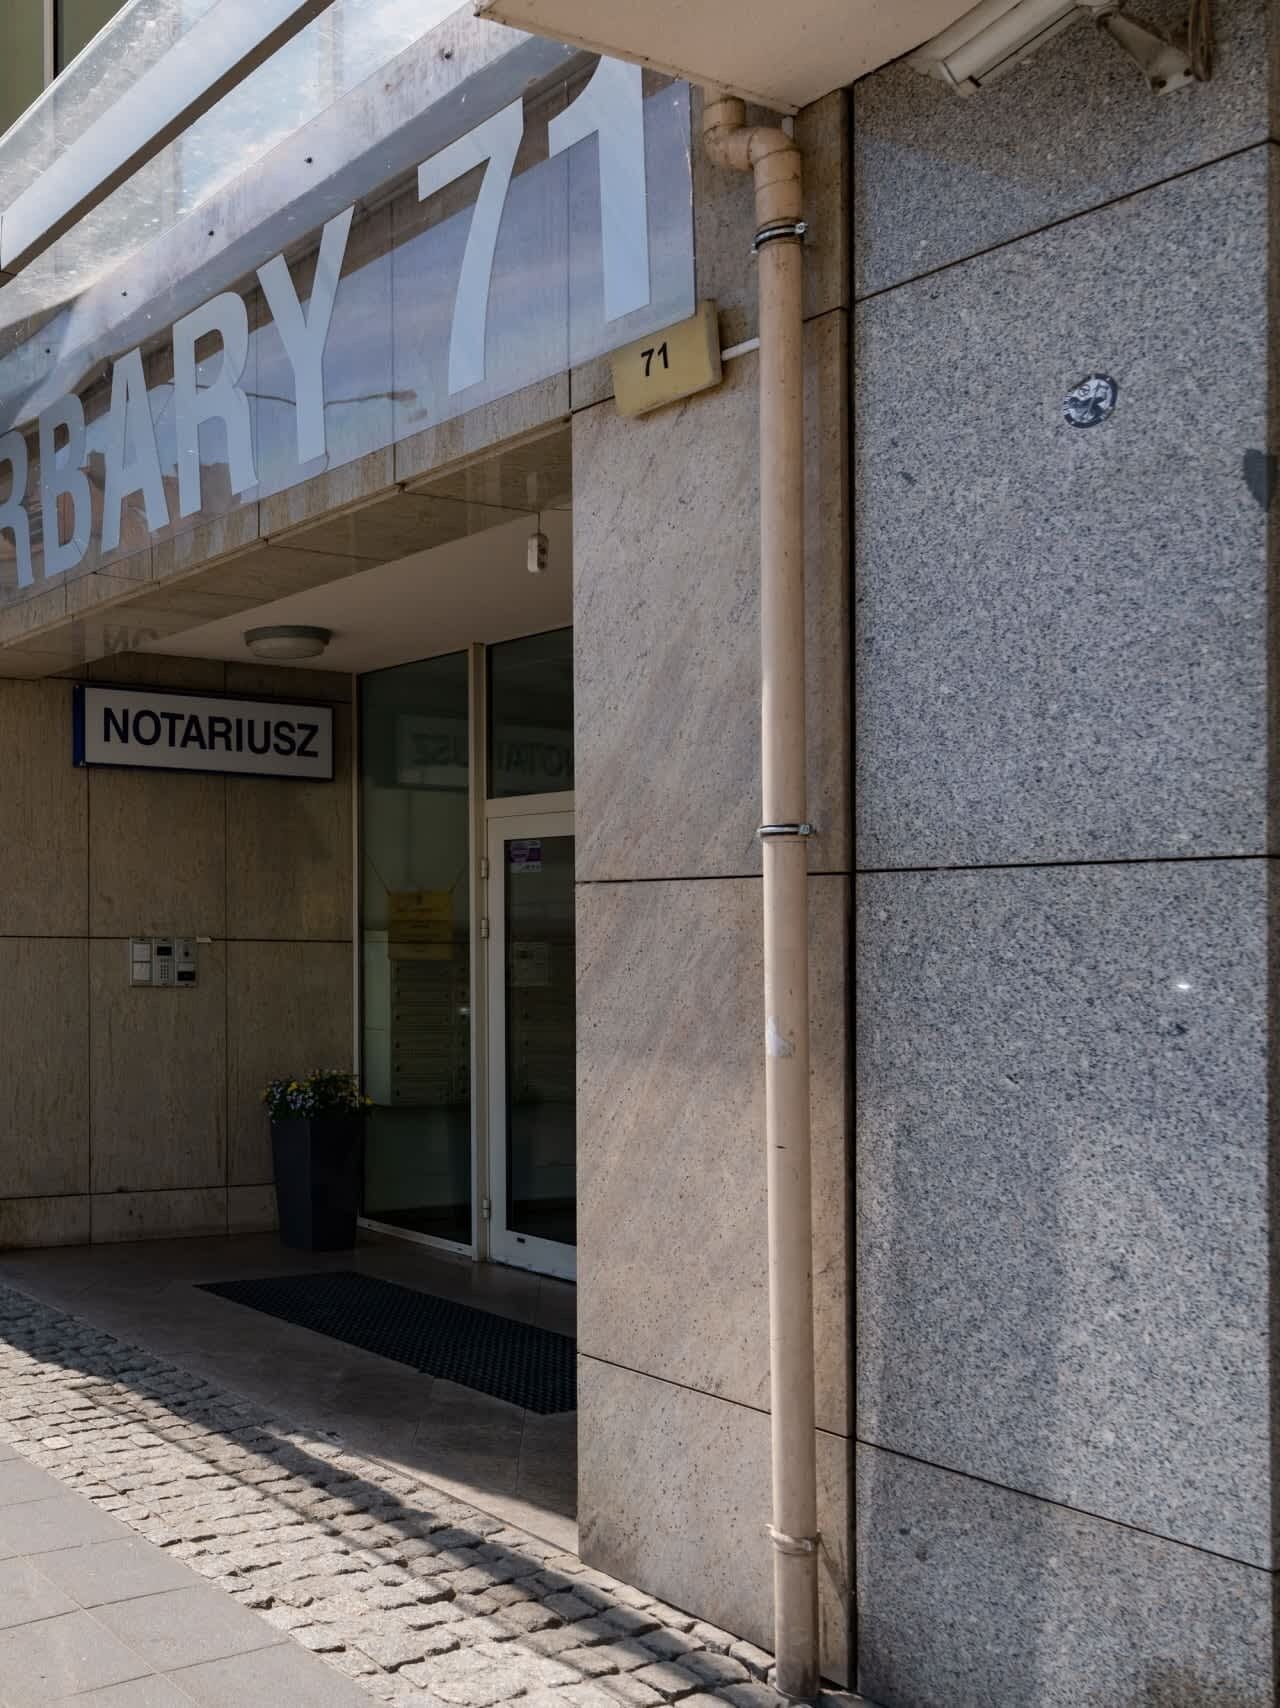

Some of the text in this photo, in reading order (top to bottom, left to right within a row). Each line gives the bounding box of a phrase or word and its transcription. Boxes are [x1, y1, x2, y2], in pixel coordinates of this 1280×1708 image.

[417, 54, 651, 396] 71
[640, 341, 669, 377] 71
[103, 706, 320, 758] NOTARIUSZ
